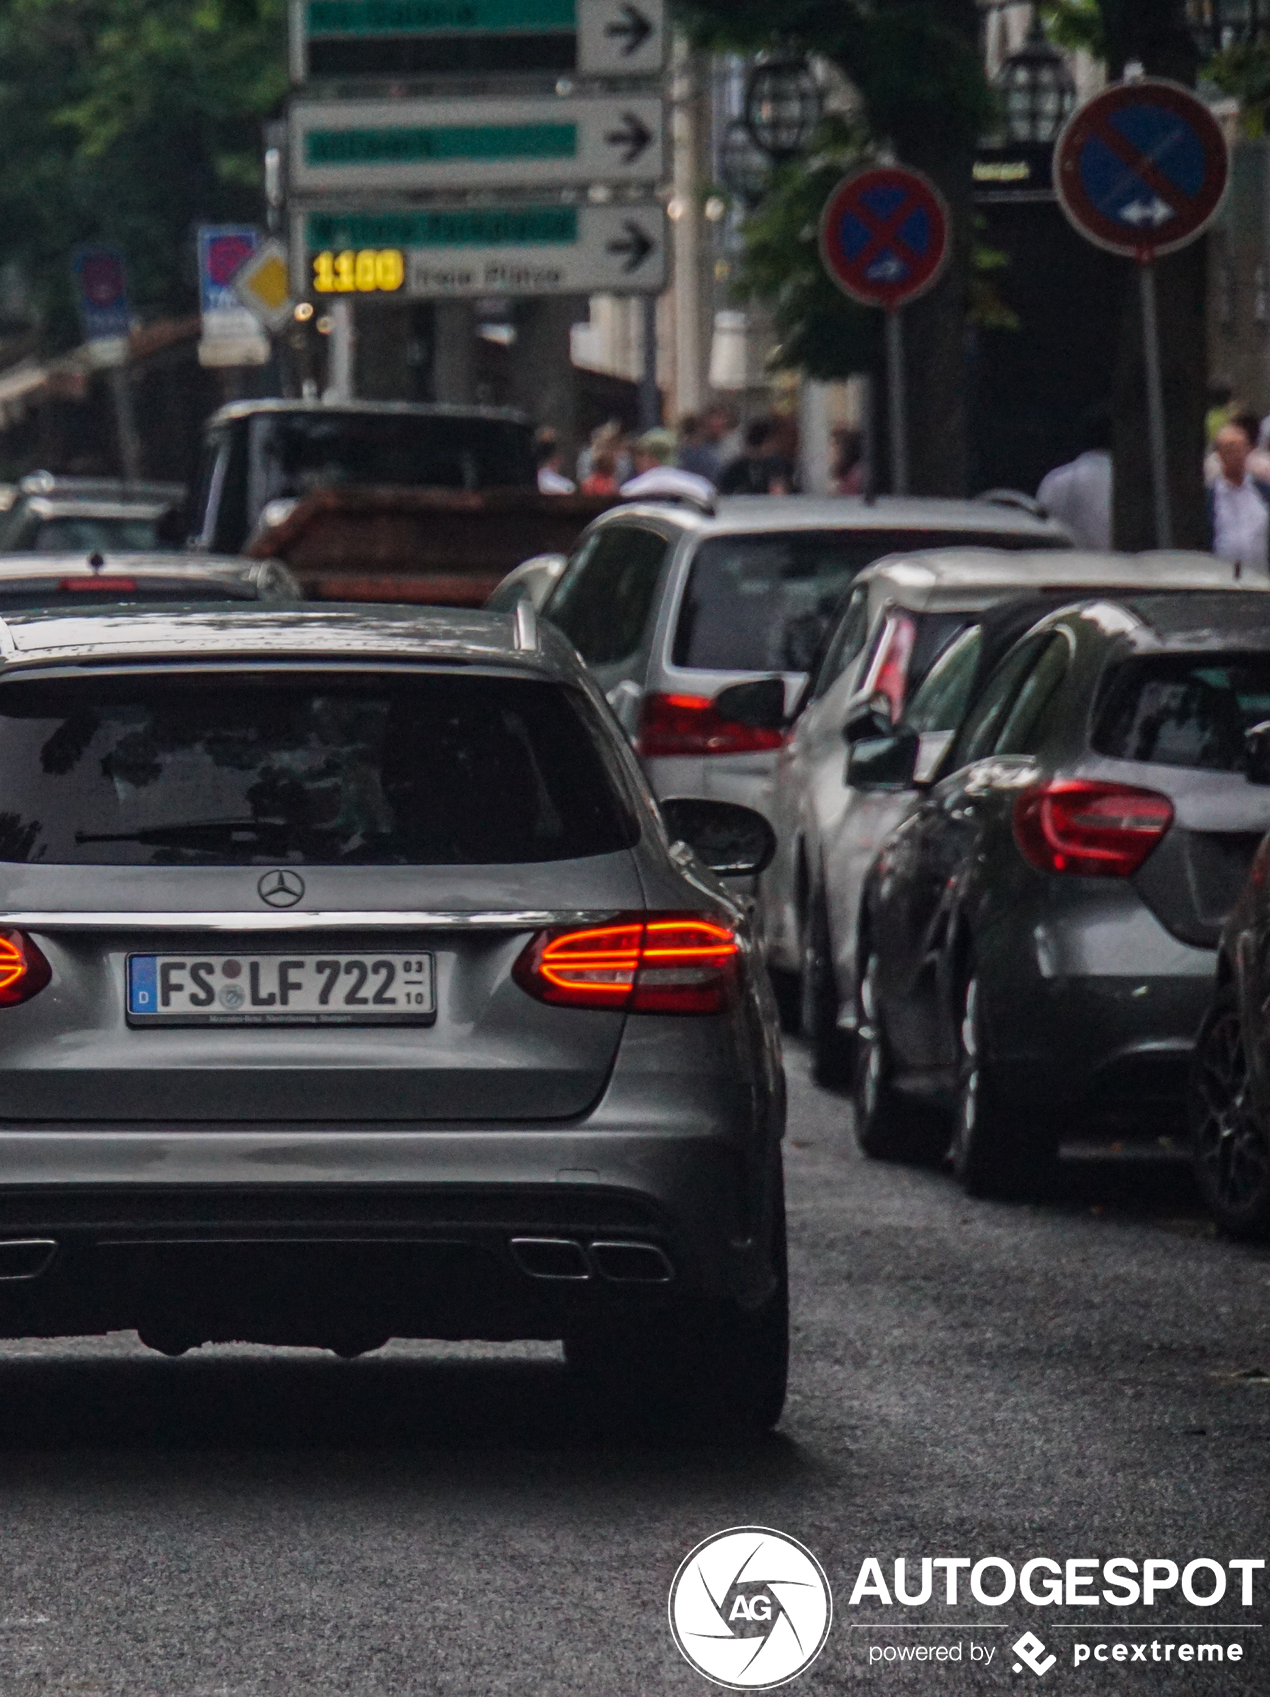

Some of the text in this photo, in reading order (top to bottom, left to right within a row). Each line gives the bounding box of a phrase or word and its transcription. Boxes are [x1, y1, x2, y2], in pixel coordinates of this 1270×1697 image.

[313, 248, 405, 293] 1100
[403, 960, 423, 974] 03
[160, 960, 397, 1008] FS LF 722
[138, 990, 150, 1005] D
[404, 991, 424, 1005] 10
